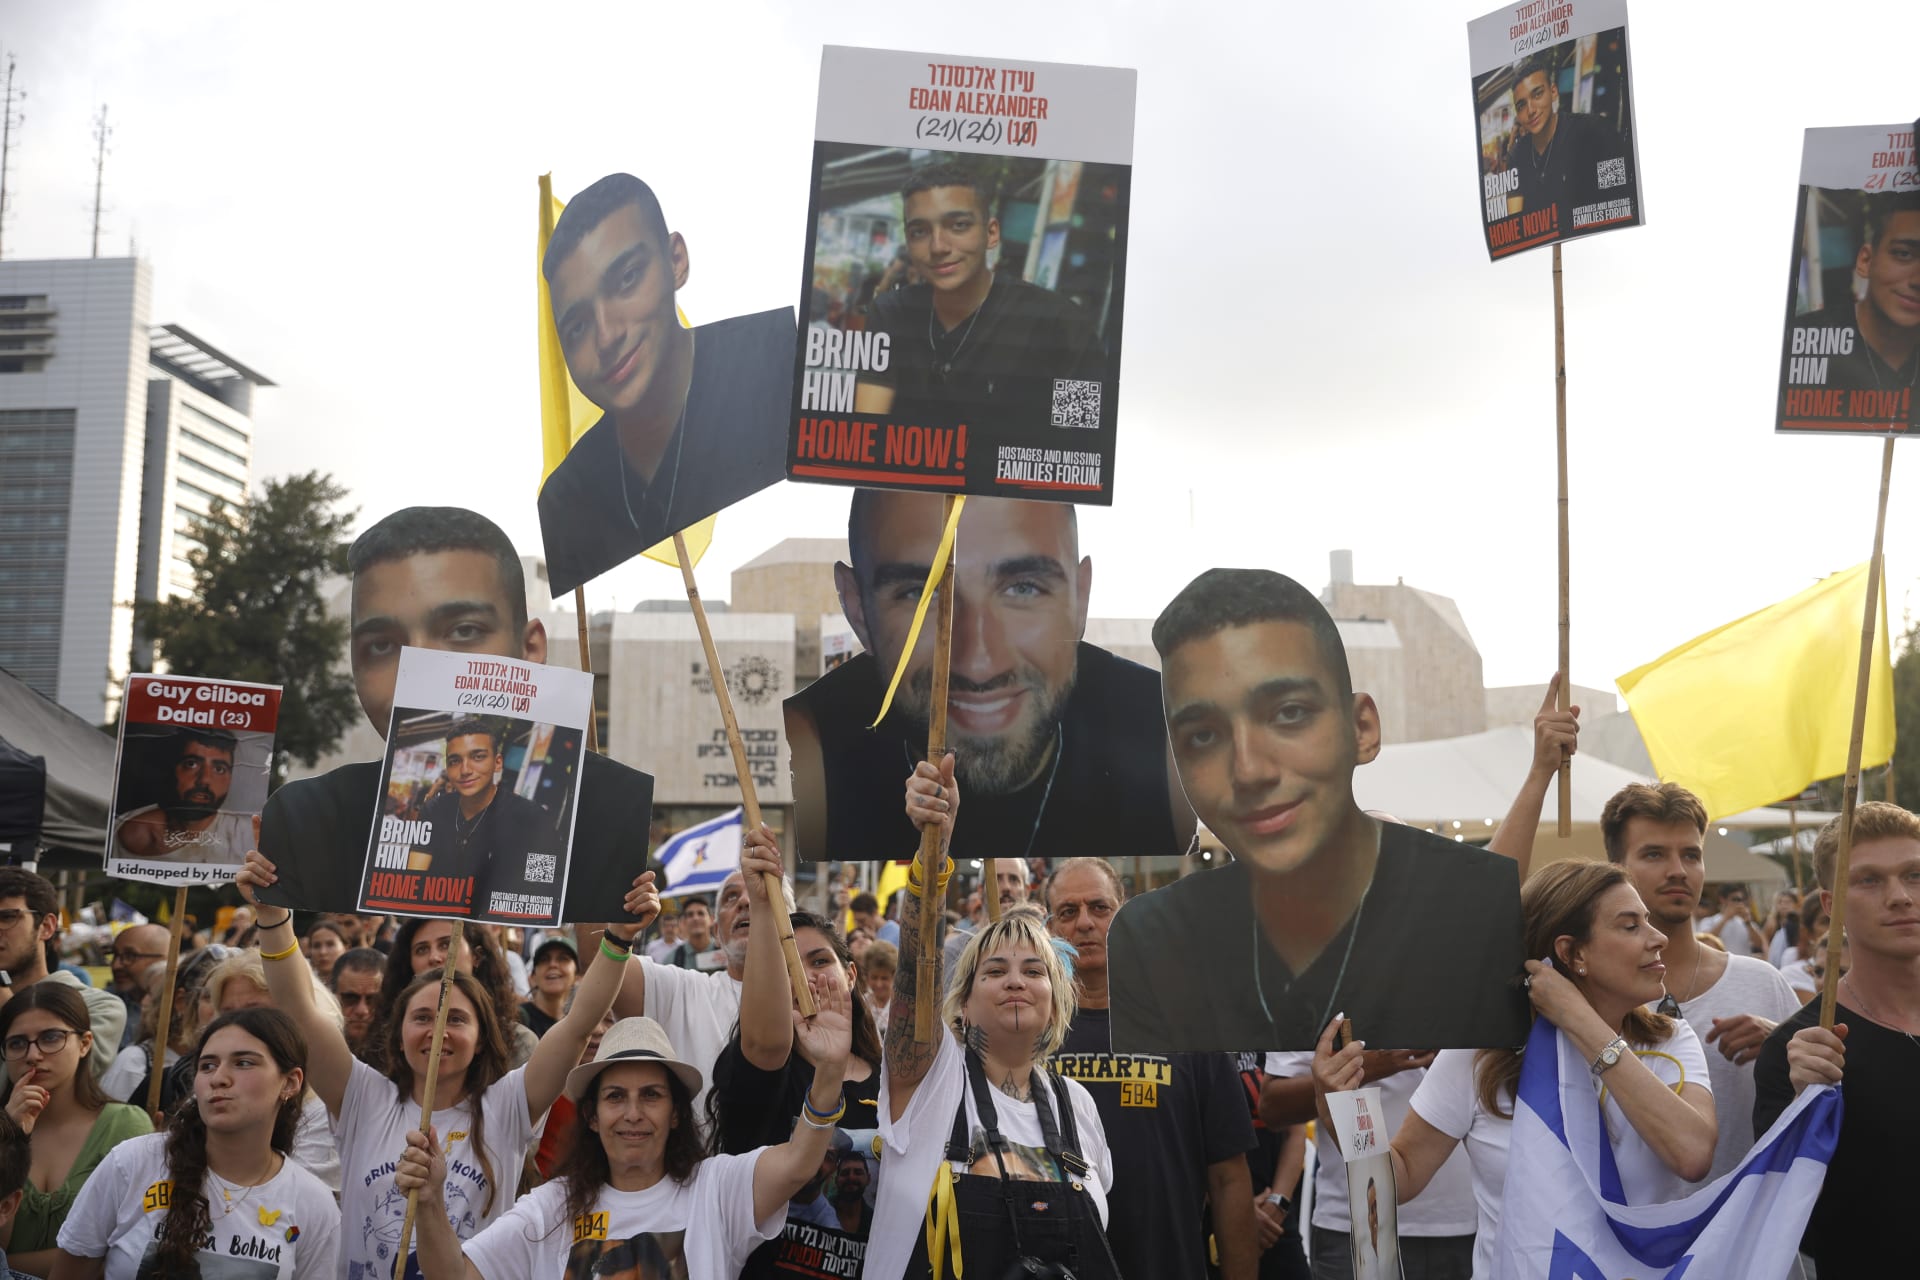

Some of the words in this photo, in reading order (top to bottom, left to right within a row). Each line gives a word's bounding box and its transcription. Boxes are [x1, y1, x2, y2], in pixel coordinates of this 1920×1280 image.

[1510, 21, 1528, 40] EDAN
[1530, 3, 1574, 32] ALEXANDER
[927, 63, 996, 91] אלכסנדר
[1001, 69, 1035, 93] עידן
[909, 87, 952, 113] EDAN
[955, 91, 1048, 120] ALEXANDER
[1872, 151, 1905, 168] EDAN
[1484, 168, 1519, 199] BRING
[1864, 172, 1888, 189] 21
[1486, 194, 1508, 222] HIM
[1573, 209, 1604, 226] FAMILIES
[1605, 206, 1631, 220] FORUM
[1488, 218, 1521, 248] HOME
[1522, 202, 1558, 237] NOW!
[804, 327, 890, 372] BRING
[1791, 327, 1854, 355] BRING
[1788, 357, 1828, 384] HIM
[801, 372, 856, 413] HIM
[1785, 388, 1845, 417] HOME
[1848, 387, 1910, 419] NOW!
[797, 418, 878, 463] HOME
[884, 424, 967, 470] NOW!
[998, 446, 1042, 462] HOSTAGES
[1043, 449, 1061, 464] AND
[1063, 451, 1101, 466] MISSING
[997, 460, 1053, 483] FAMILIES
[1056, 464, 1101, 486] FORUM
[467, 661, 508, 678] אלכסנדר
[510, 666, 530, 681] עידן
[146, 682, 192, 704] Guy
[195, 685, 265, 706] Gilboa
[455, 675, 481, 690] EDAN
[482, 678, 538, 698] ALEXANDER
[157, 705, 214, 725] Dalal
[220, 710, 251, 728] (23)
[379, 817, 433, 845] BRING
[374, 843, 410, 870] HIM
[117, 863, 189, 880] kidnapped
[192, 867, 209, 880] by
[369, 871, 421, 899] HOME
[422, 876, 474, 904] NOW!
[518, 894, 529, 902] AND
[530, 895, 553, 904] MISSING
[490, 900, 524, 914] FAMILIES
[525, 903, 552, 915] FORUM
[1122, 1083, 1155, 1105] 584
[365, 1161, 397, 1187] BRIN
[451, 1160, 488, 1191] HOME
[145, 1182, 169, 1208] 58
